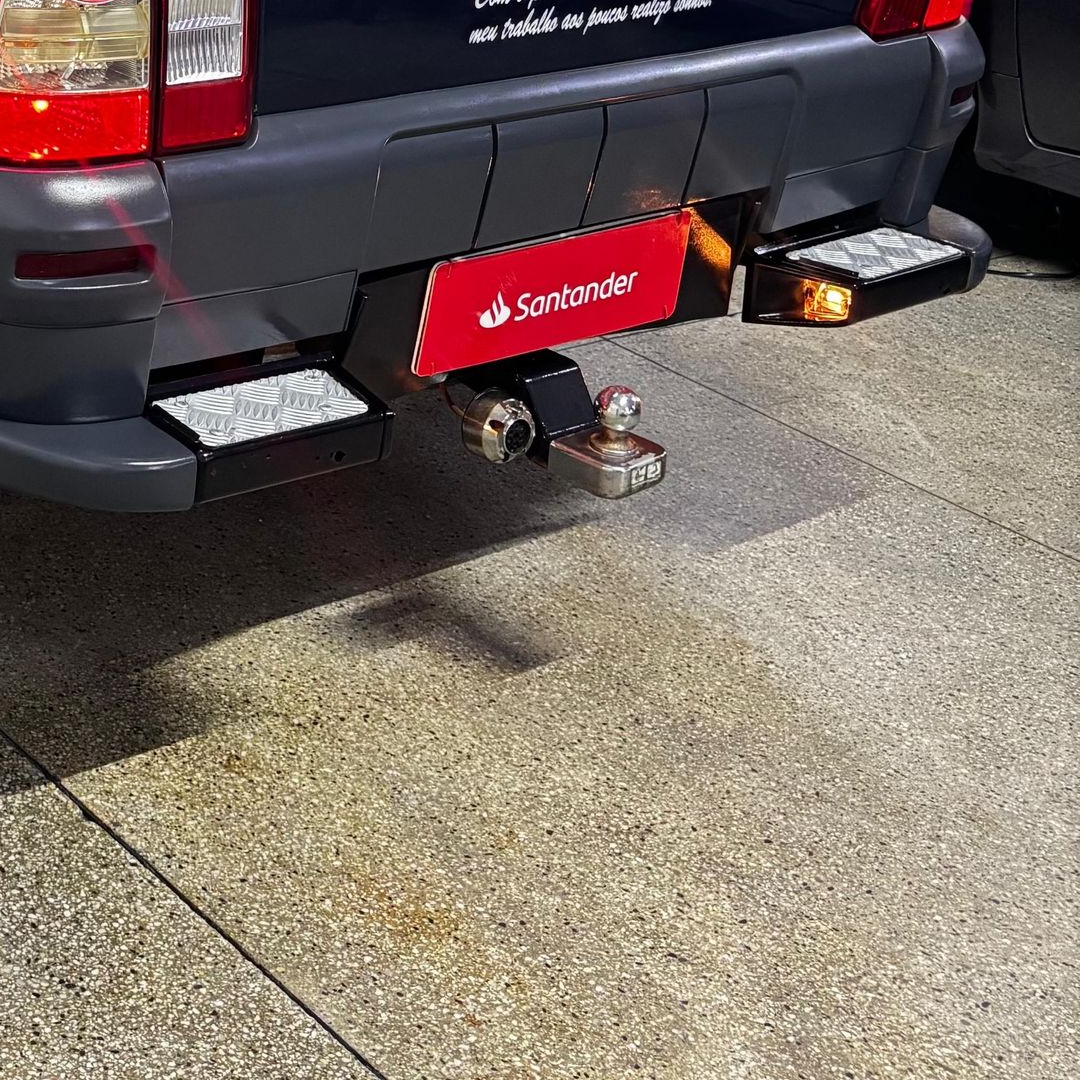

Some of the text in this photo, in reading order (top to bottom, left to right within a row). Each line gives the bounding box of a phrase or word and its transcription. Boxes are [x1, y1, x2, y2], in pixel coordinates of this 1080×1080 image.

[469, 22, 499, 44] meu
[501, 6, 558, 40] trabalho
[561, 13, 584, 32] aos
[584, 4, 628, 34] poucos
[514, 271, 638, 321] Santander
